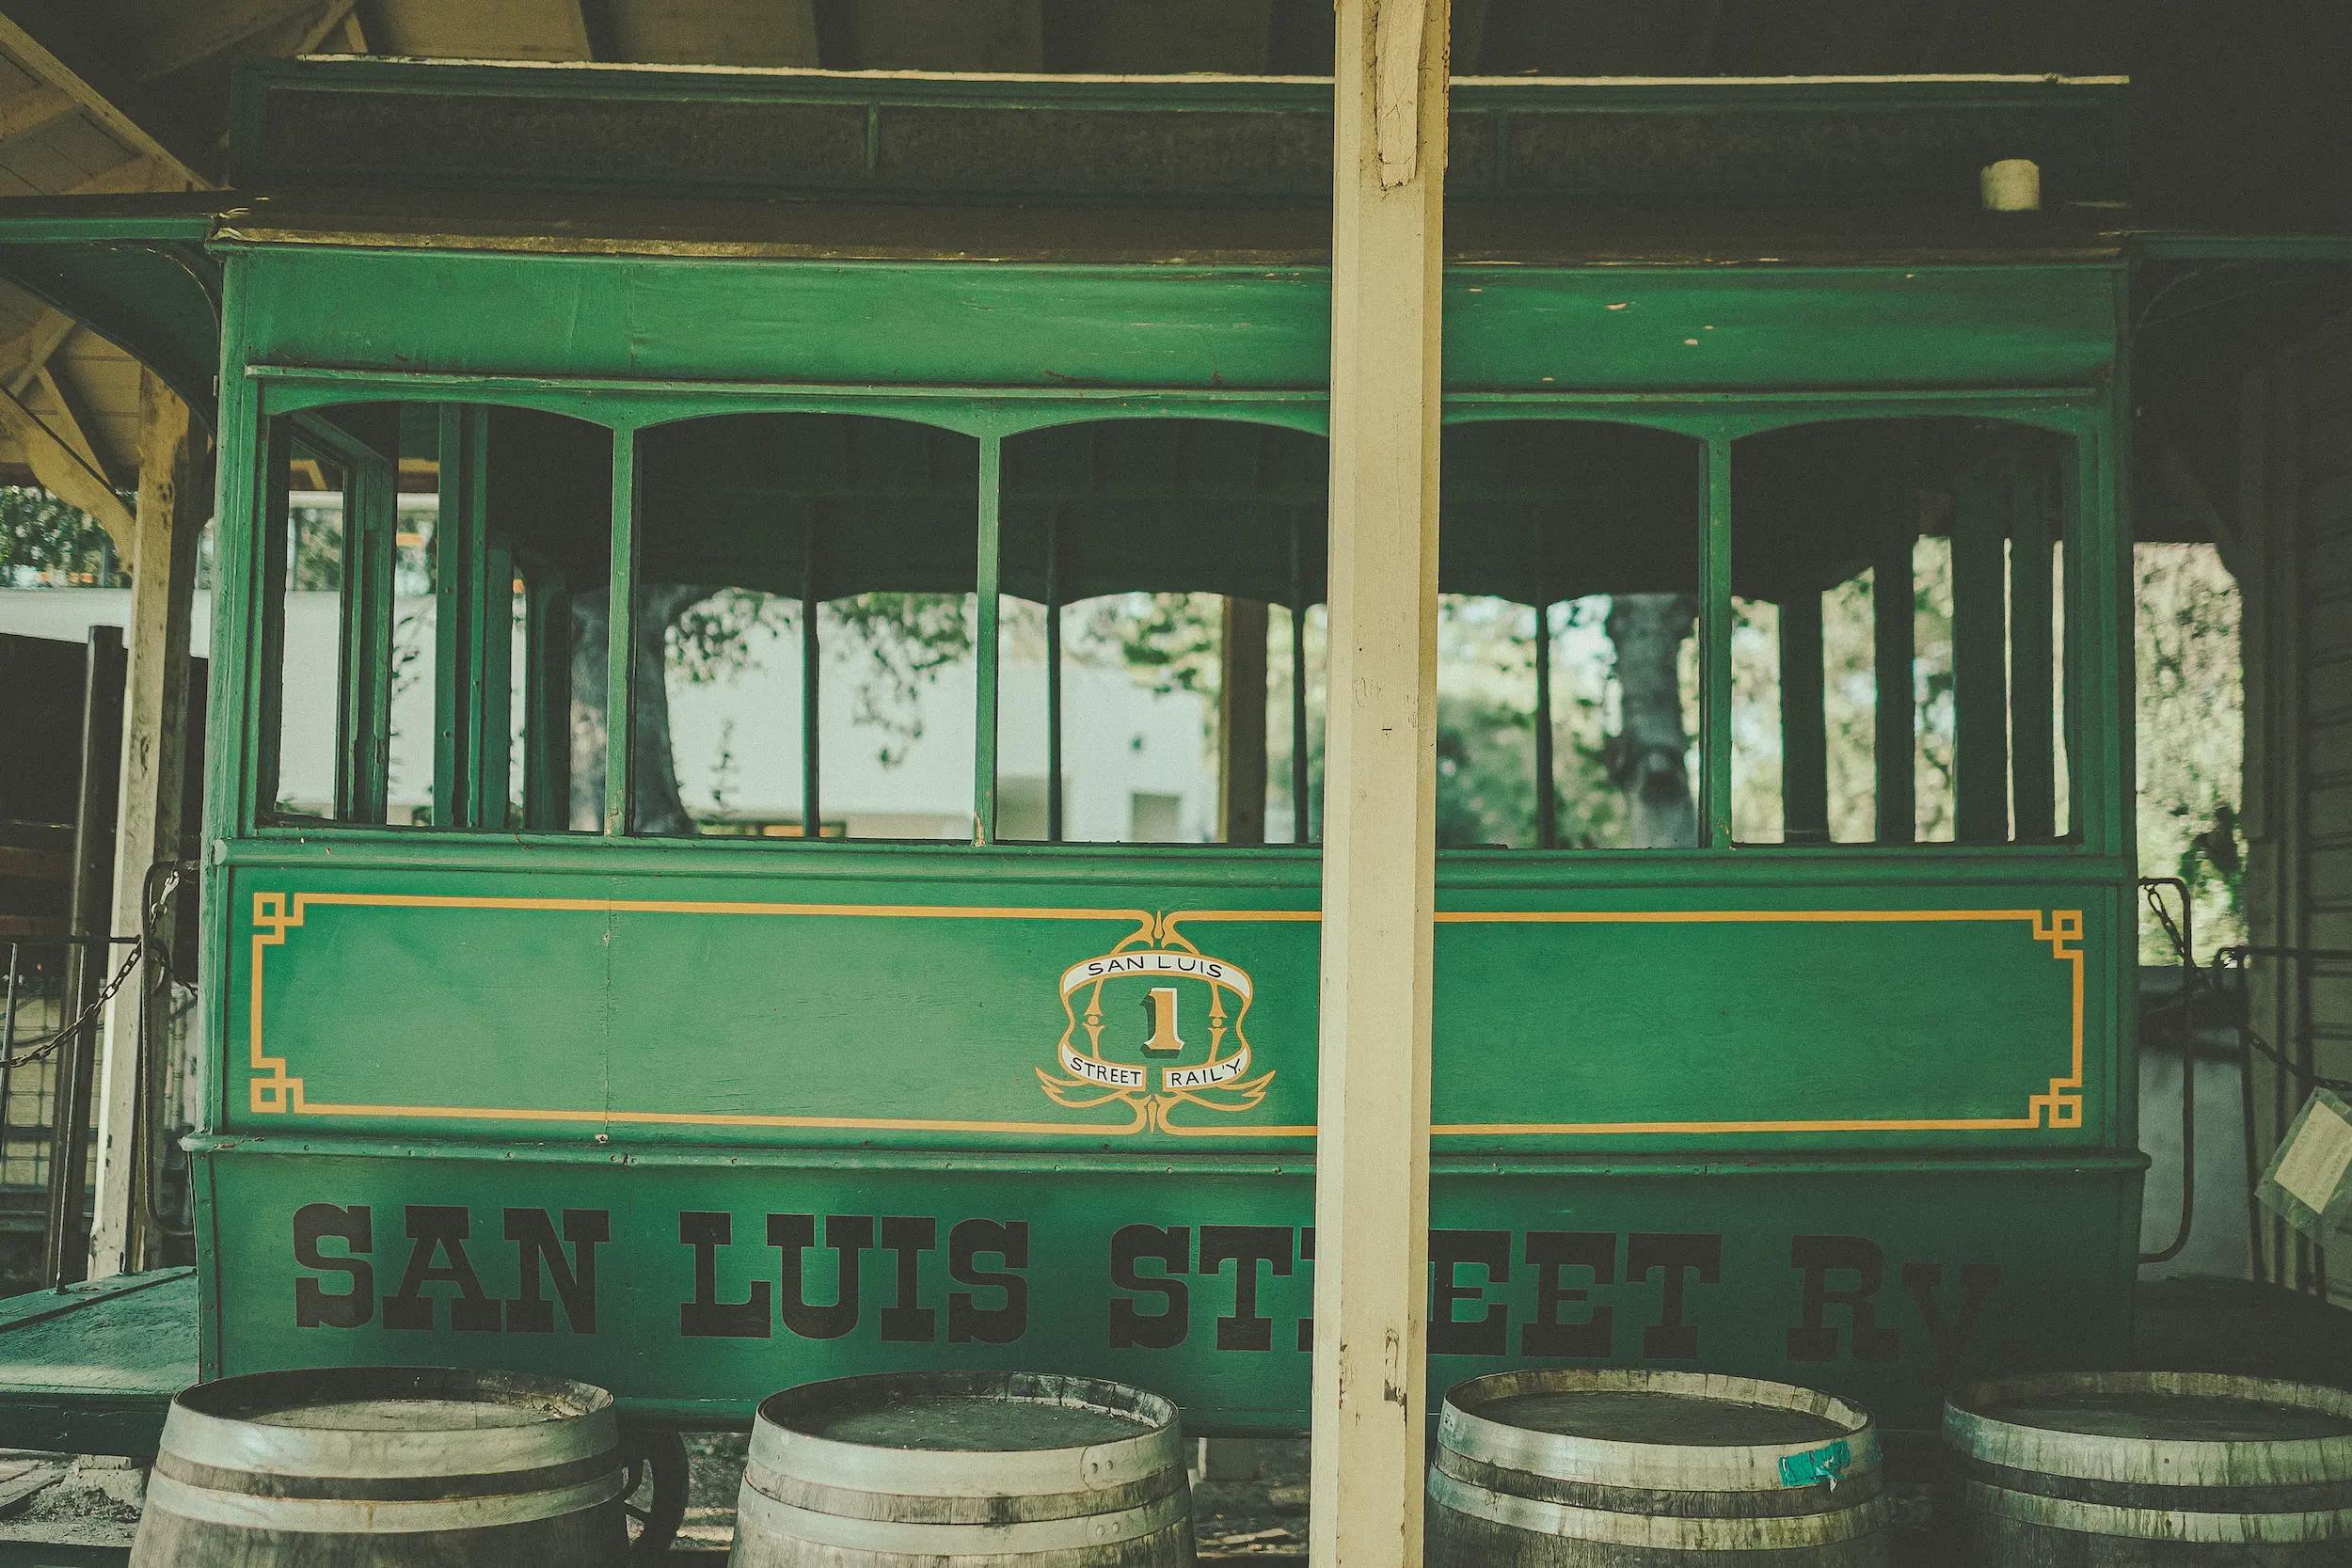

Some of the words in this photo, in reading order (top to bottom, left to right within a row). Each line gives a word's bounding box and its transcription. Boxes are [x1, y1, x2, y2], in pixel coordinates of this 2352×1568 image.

[1089, 957, 1144, 976] SAN
[1158, 956, 1222, 978] LUIS
[1139, 987, 1185, 1059] 1
[1070, 1057, 1141, 1085] STREET
[294, 1203, 610, 1334] SAN
[680, 1212, 1031, 1344] LUIS
[1110, 1224, 1723, 1359] STEET
